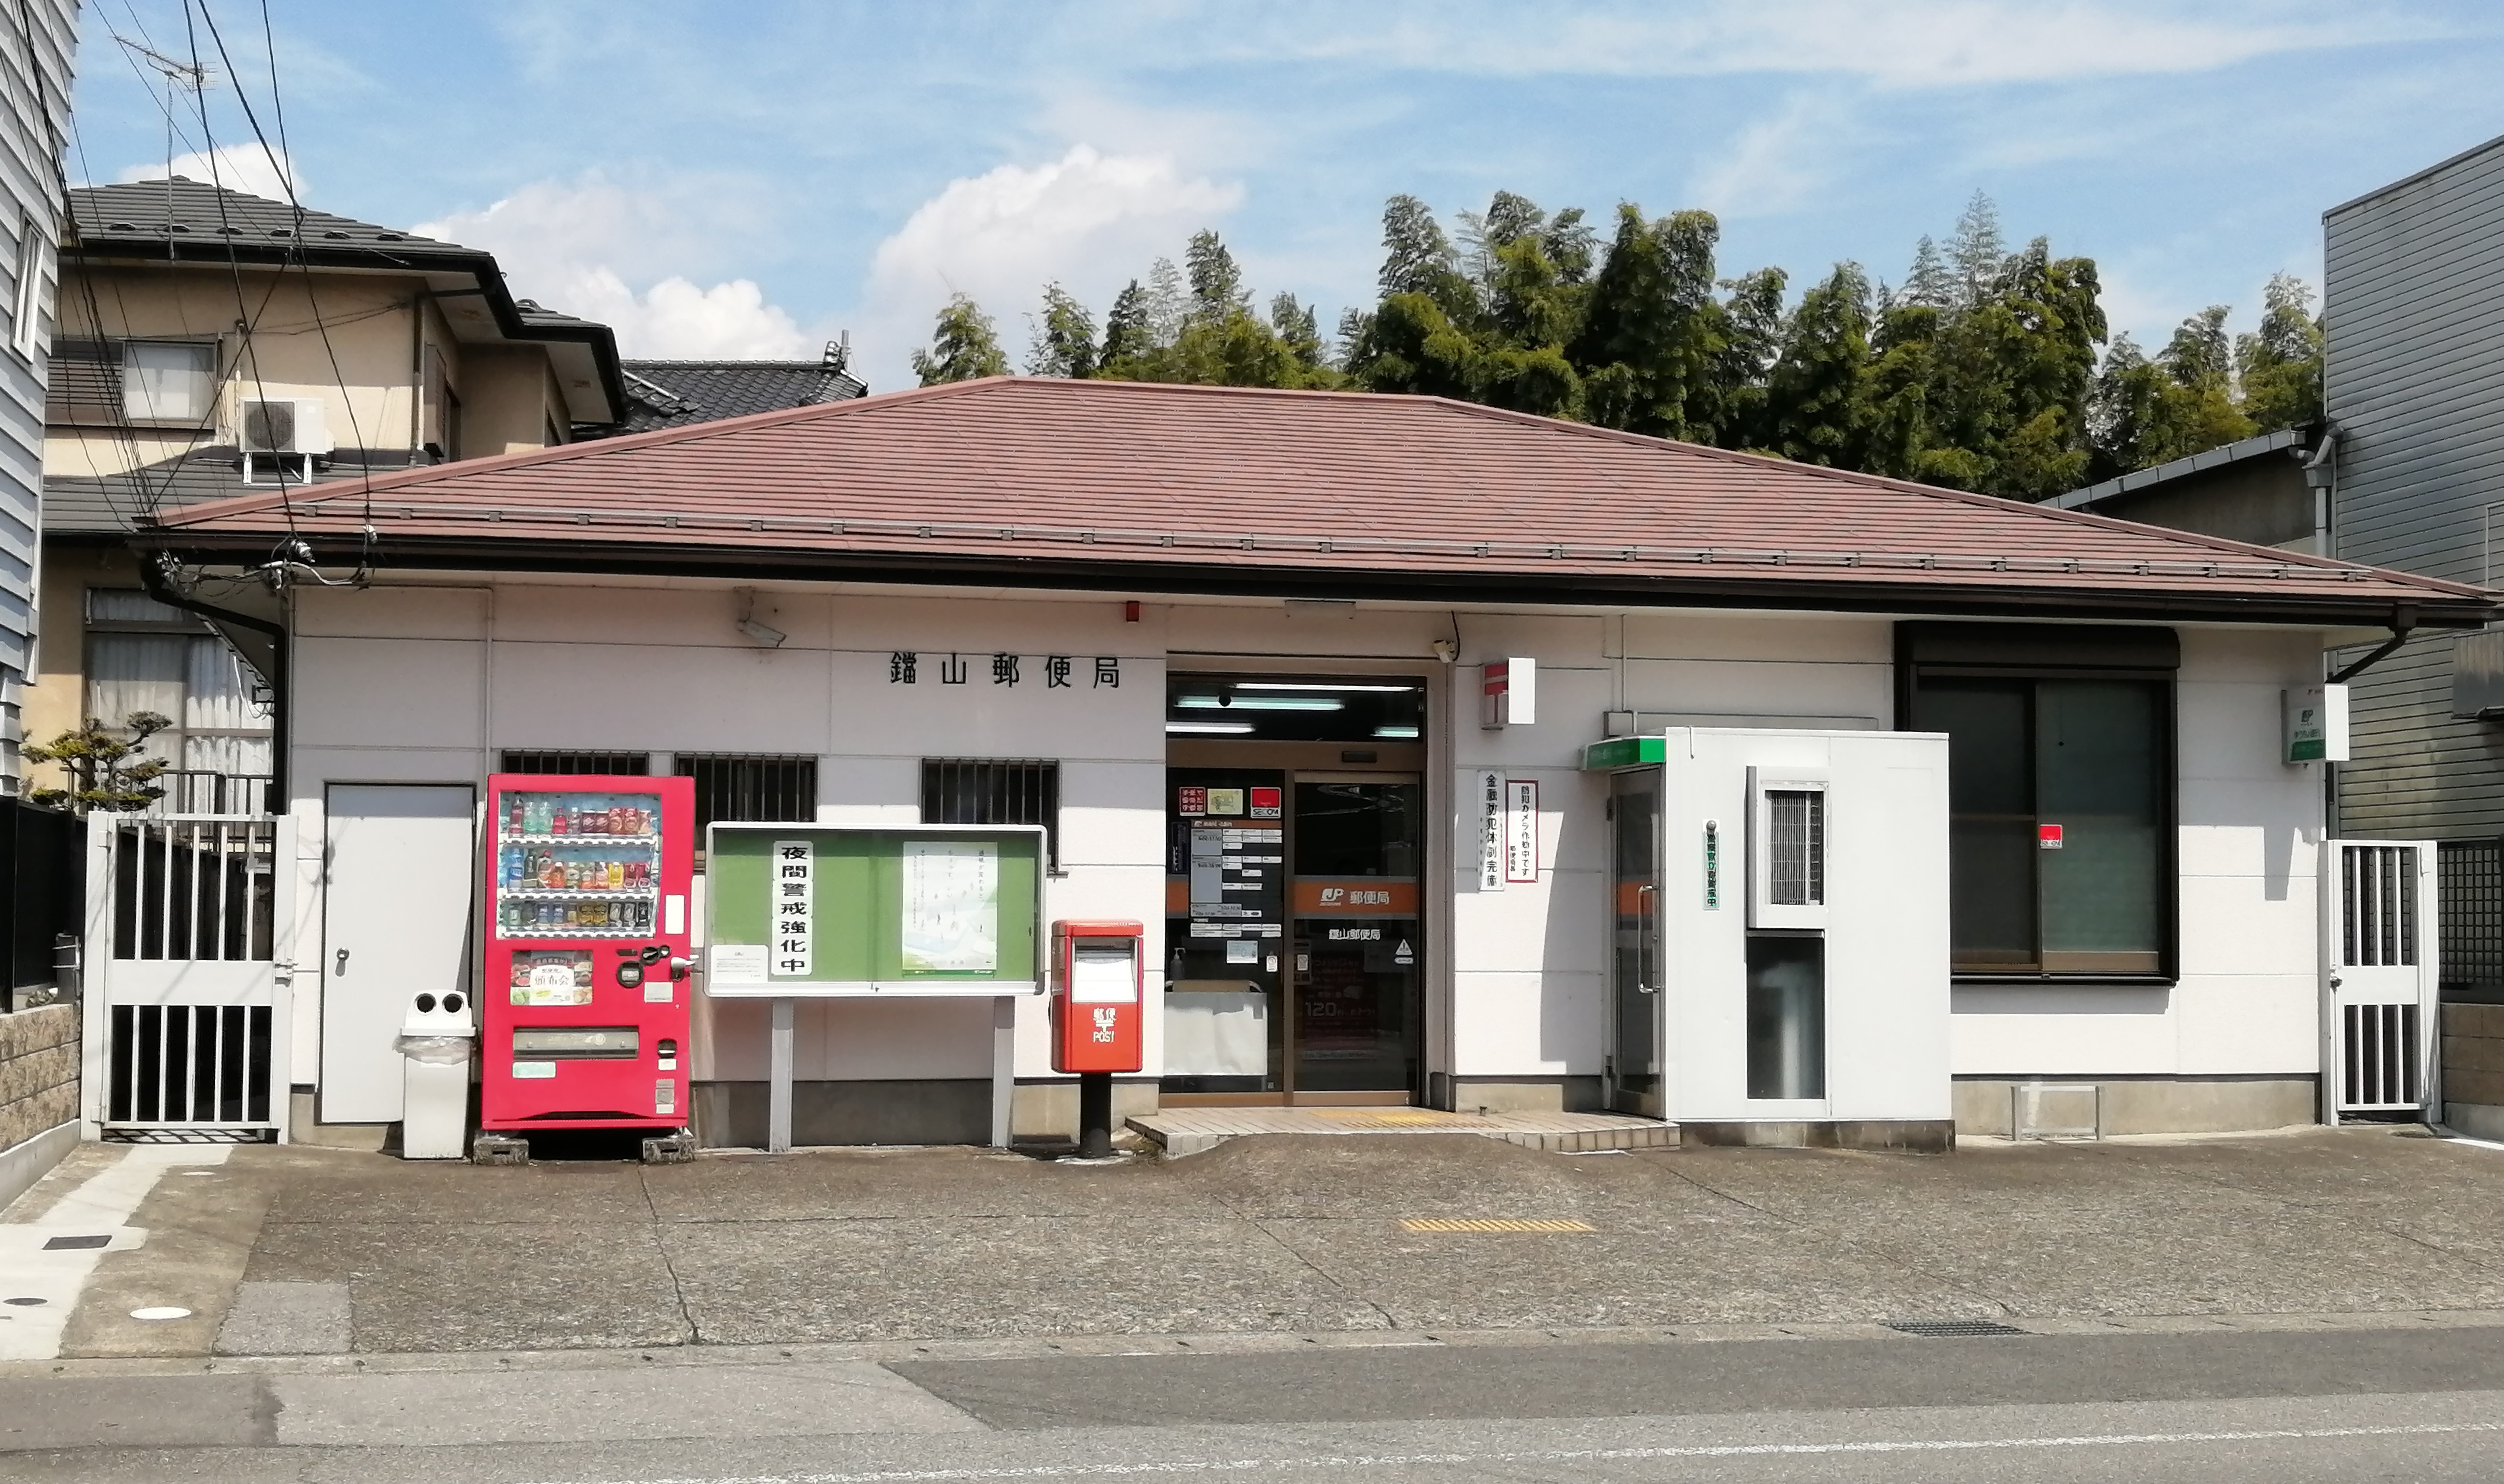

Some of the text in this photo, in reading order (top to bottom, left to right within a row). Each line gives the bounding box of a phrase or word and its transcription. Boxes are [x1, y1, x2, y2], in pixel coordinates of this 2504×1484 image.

[891, 652, 1119, 689] 鐺山郵便局
[780, 846, 808, 972] 夜間警戒強化中
[1350, 891, 1390, 905] 郵便局
